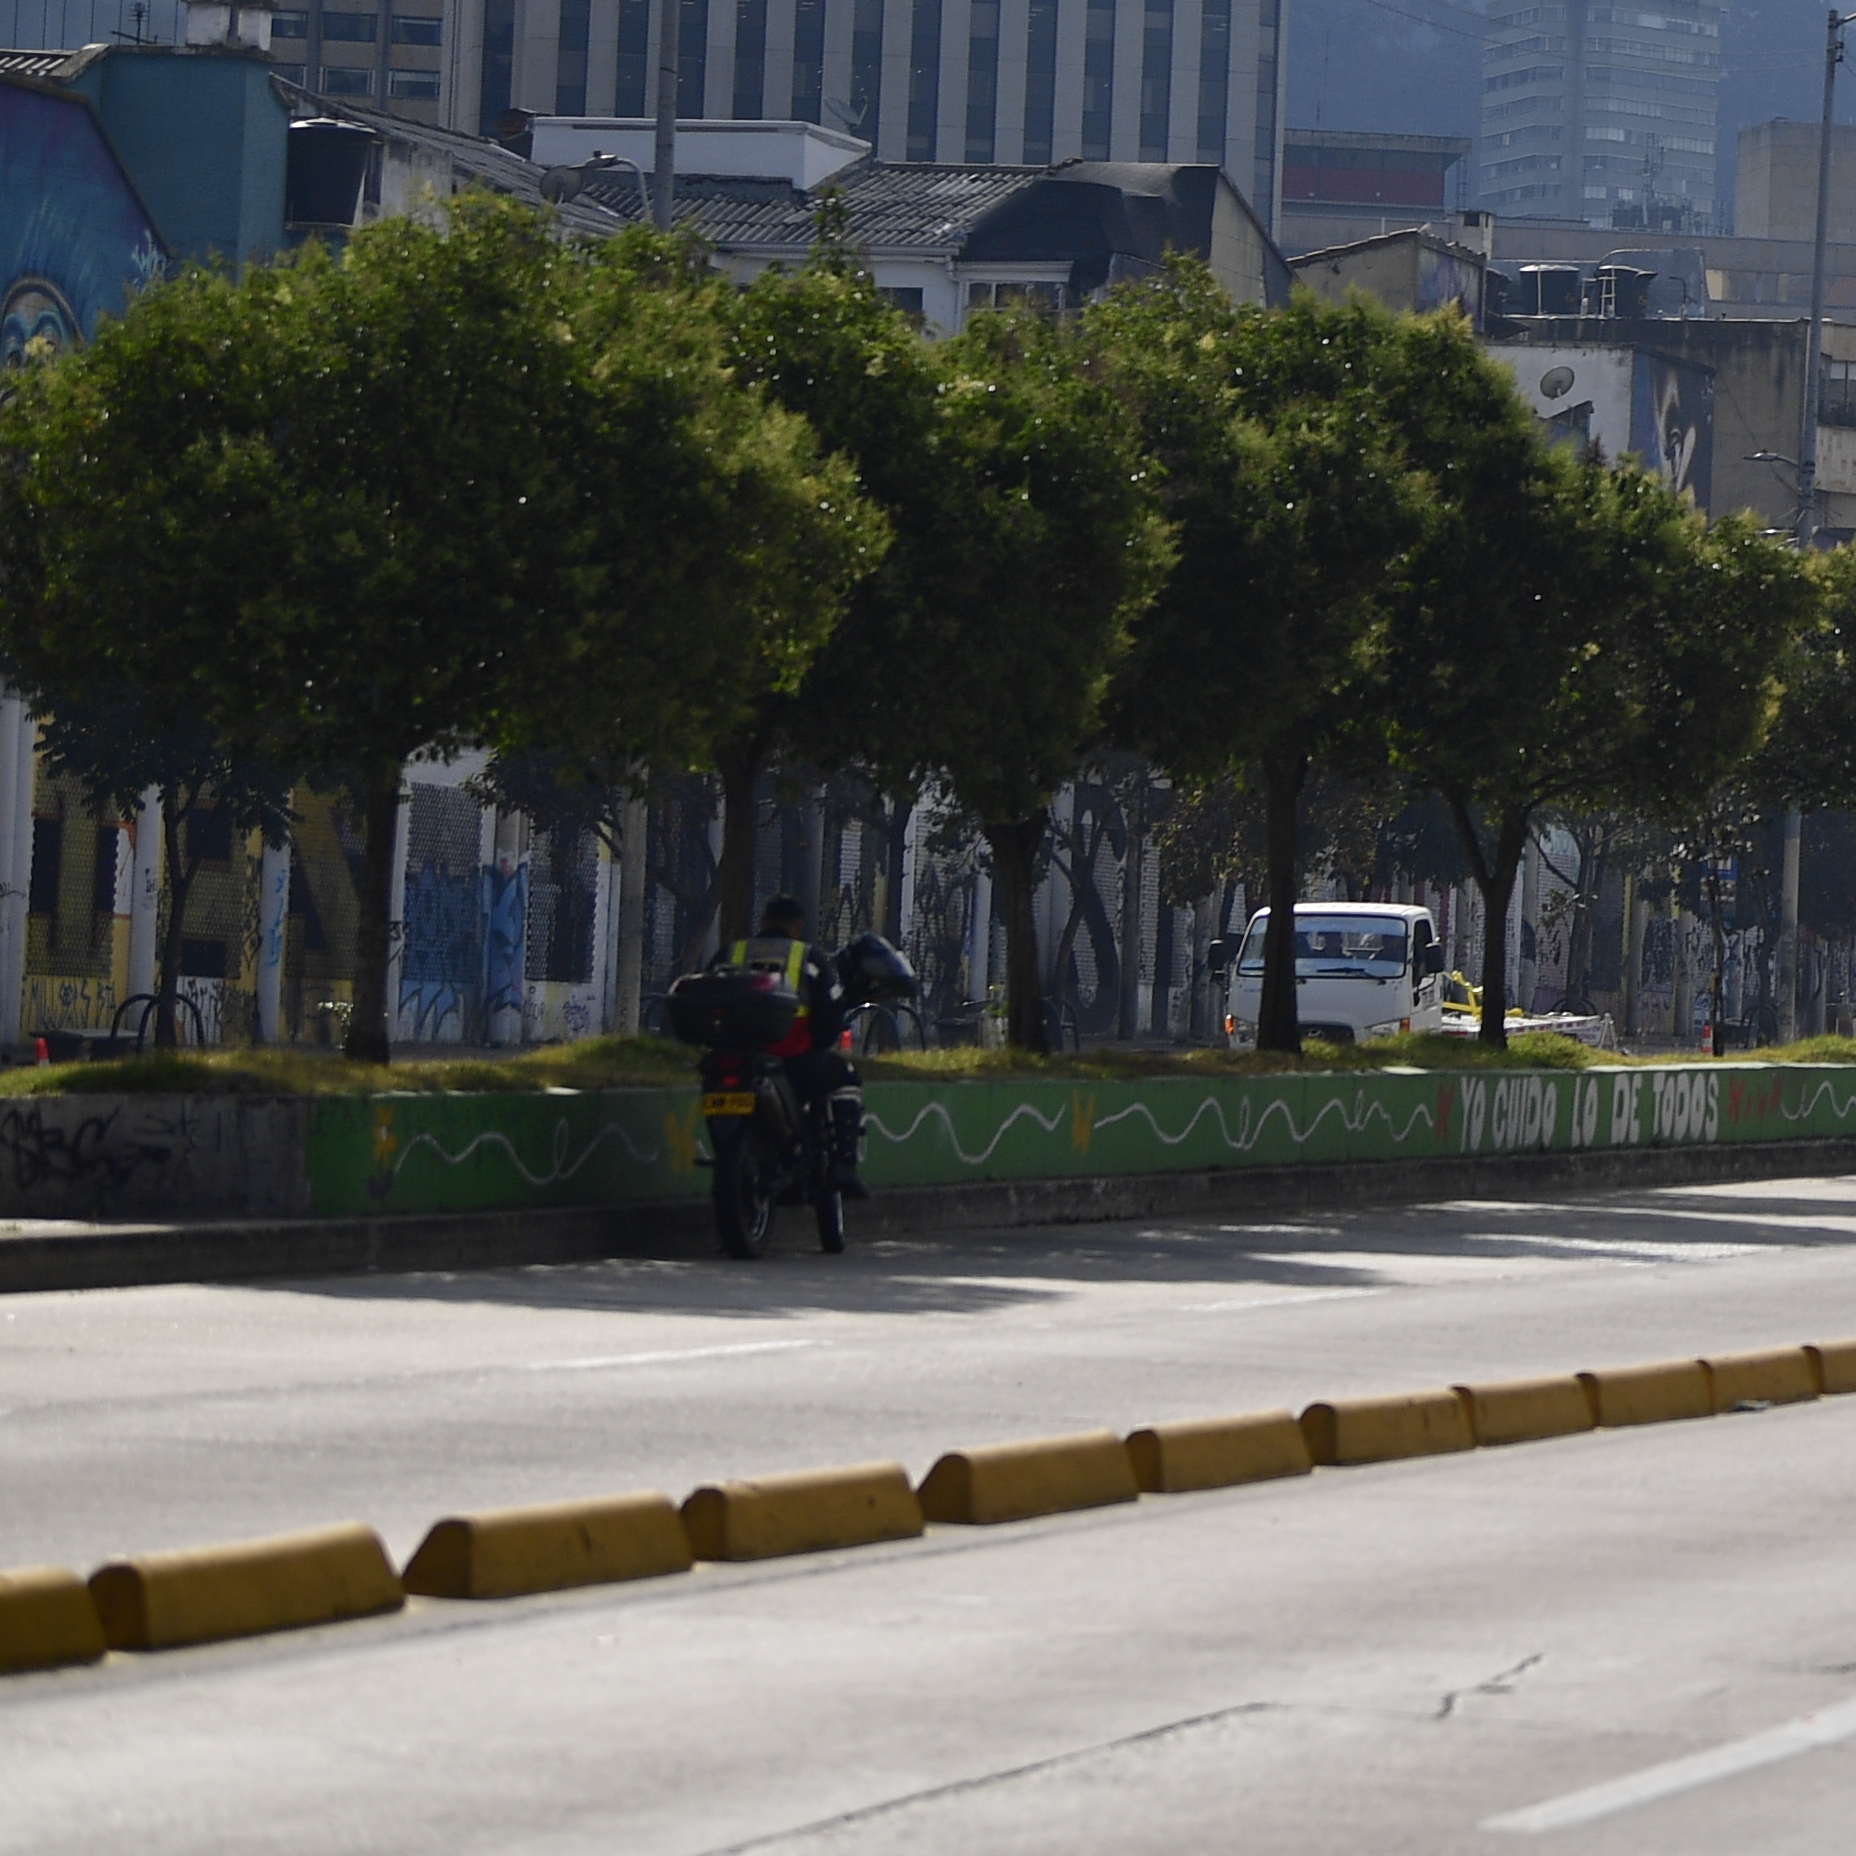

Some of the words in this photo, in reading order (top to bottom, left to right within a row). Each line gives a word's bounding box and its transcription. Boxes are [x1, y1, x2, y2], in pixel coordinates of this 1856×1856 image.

[1460, 1076, 1487, 1153] YO
[1491, 1074, 1557, 1150] CUIDO
[1571, 1075, 1598, 1148] LO
[1610, 1072, 1643, 1145] DE
[1652, 1071, 1720, 1142] TODOS
